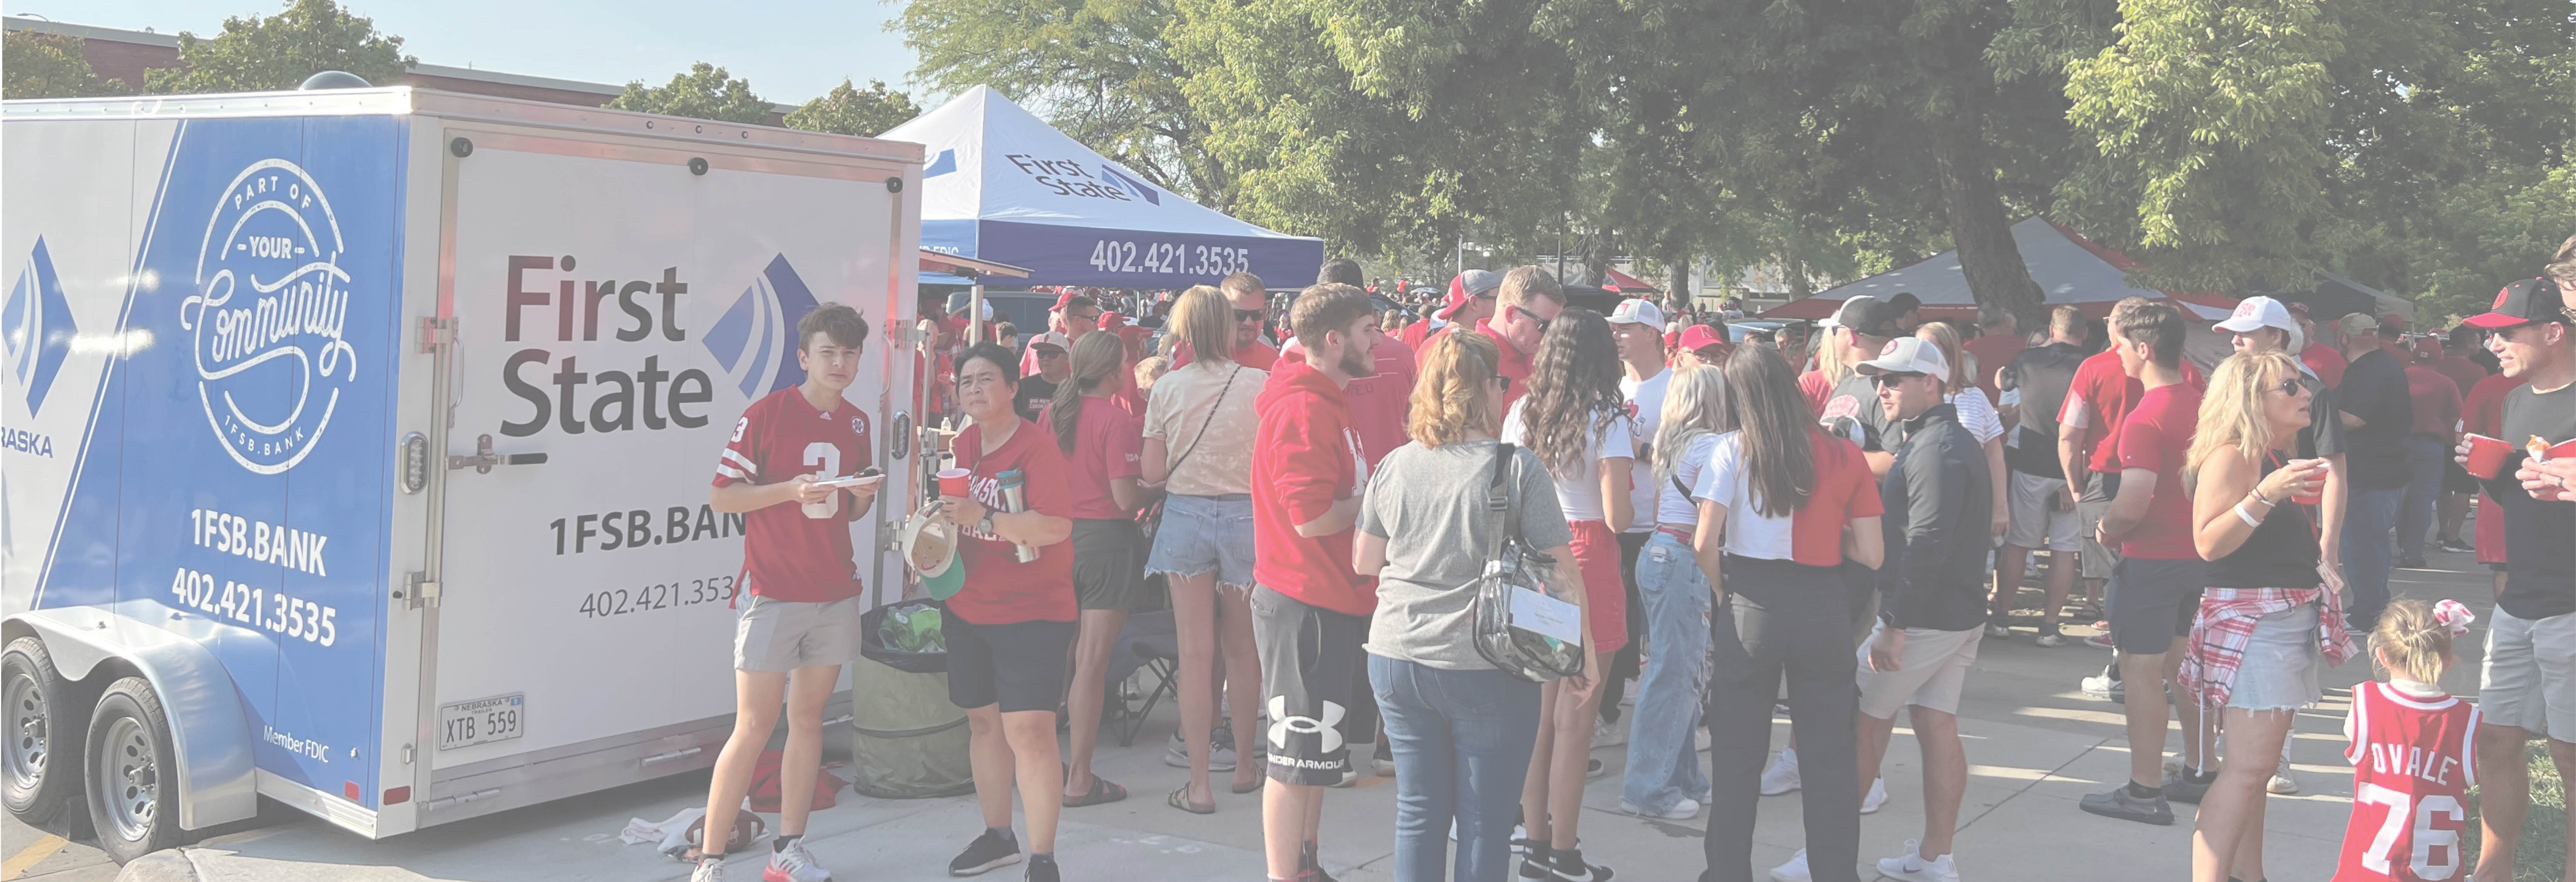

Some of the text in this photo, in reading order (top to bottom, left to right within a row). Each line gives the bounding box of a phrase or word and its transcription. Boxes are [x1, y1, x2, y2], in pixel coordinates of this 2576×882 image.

[1004, 154, 1095, 179] First
[235, 176, 311, 210] PART OF
[1035, 175, 1132, 201] State
[249, 236, 292, 259] YOUR
[1090, 240, 1249, 276] 402.421.3535
[180, 250, 357, 382] Community
[505, 254, 688, 342] First
[499, 348, 713, 438] State
[224, 415, 304, 456] 1FSB.BANK
[731, 416, 748, 443] 3
[801, 442, 840, 519] 3
[192, 509, 328, 577] 1FSB.BANK
[550, 503, 746, 555] 1FSB.BAN
[172, 567, 336, 647] 402.421.3535
[579, 575, 733, 618] 402.421.353
[461, 699, 503, 711] NEBRASKA
[264, 724, 329, 763] Member FDIC
[446, 710, 517, 743] XTB 559
[2357, 781, 2464, 881] 76
